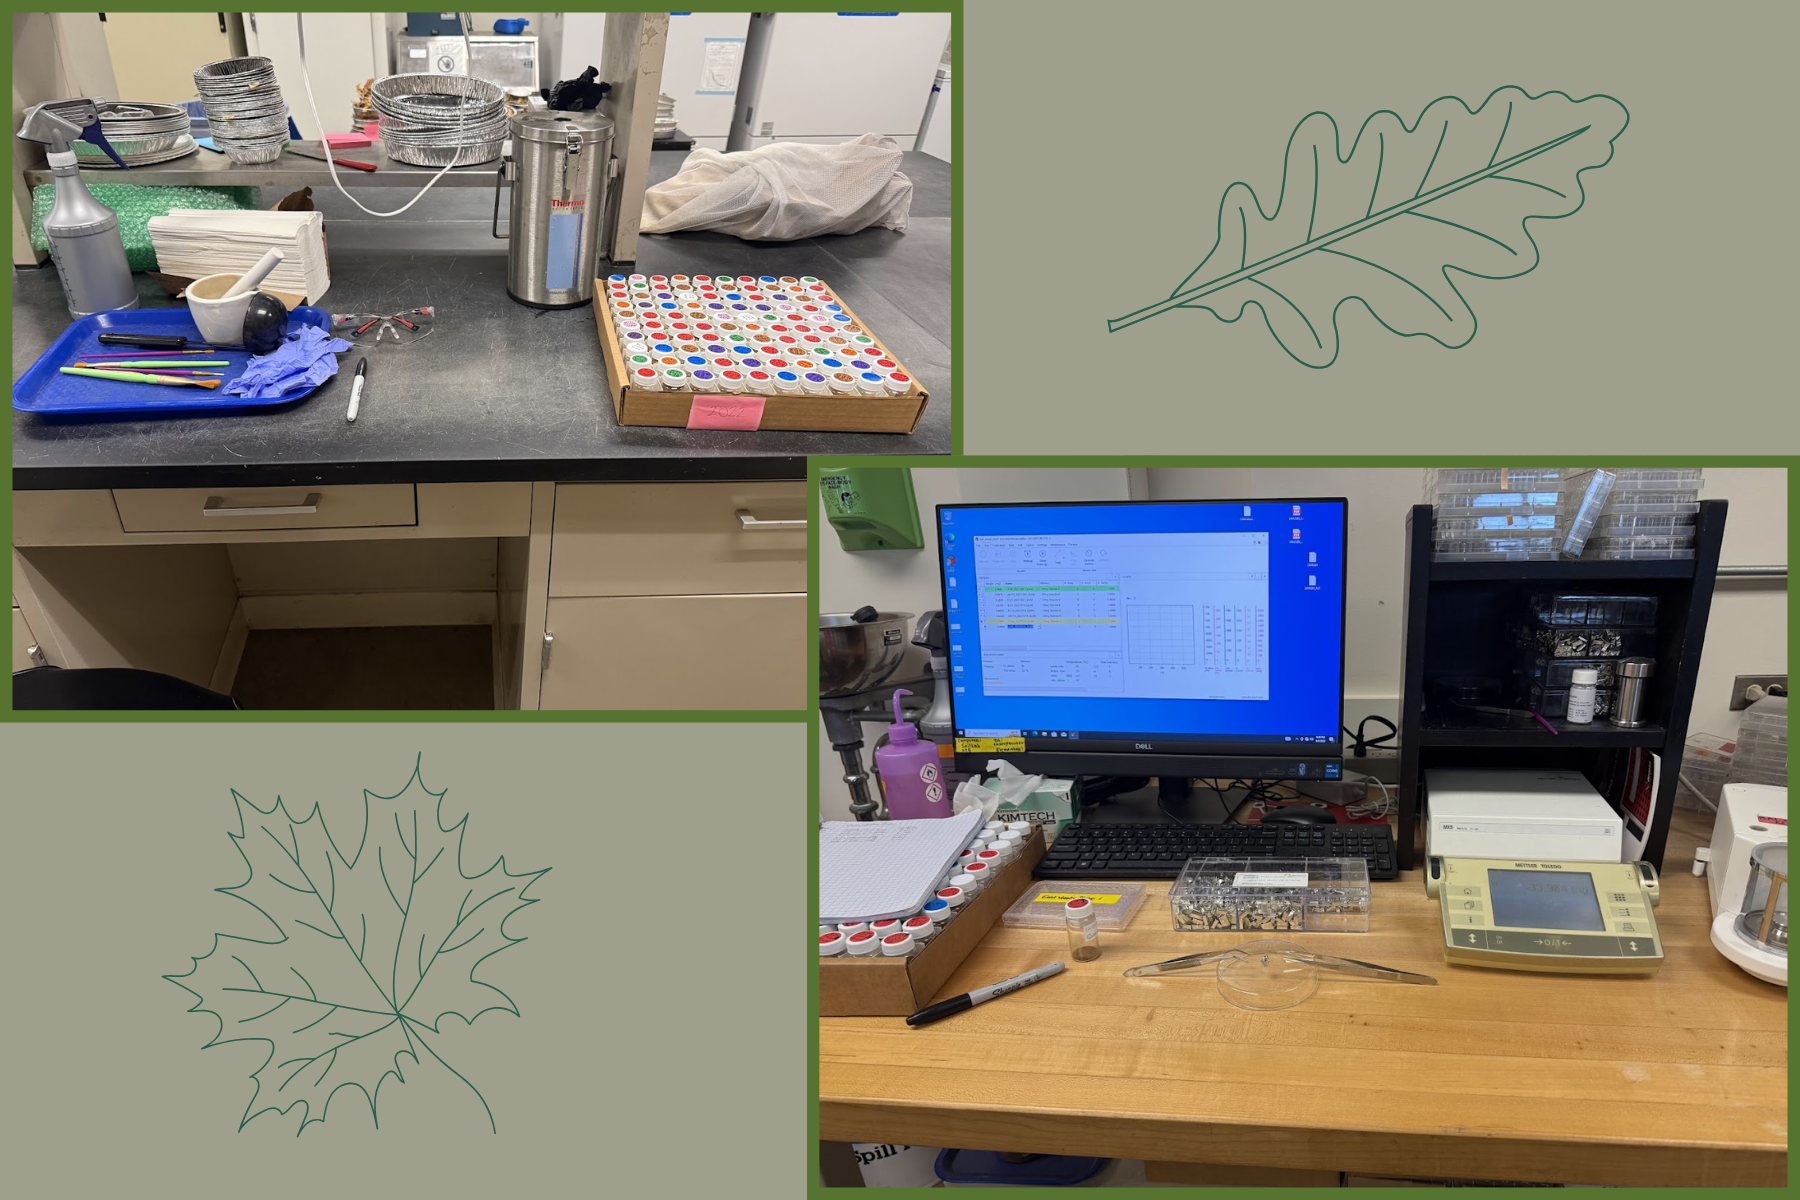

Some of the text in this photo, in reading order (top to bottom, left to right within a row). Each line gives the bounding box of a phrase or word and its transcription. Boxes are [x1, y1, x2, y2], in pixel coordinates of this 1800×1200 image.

[551, 199, 585, 207] Thermo
[707, 405, 746, 418] 2022
[1065, 792, 1070, 801] 1
[997, 811, 1056, 822] KIMTECH
[1571, 886, 1589, 896] mg
[992, 982, 1021, 997] Sharpie
[854, 1144, 898, 1165] Spill
